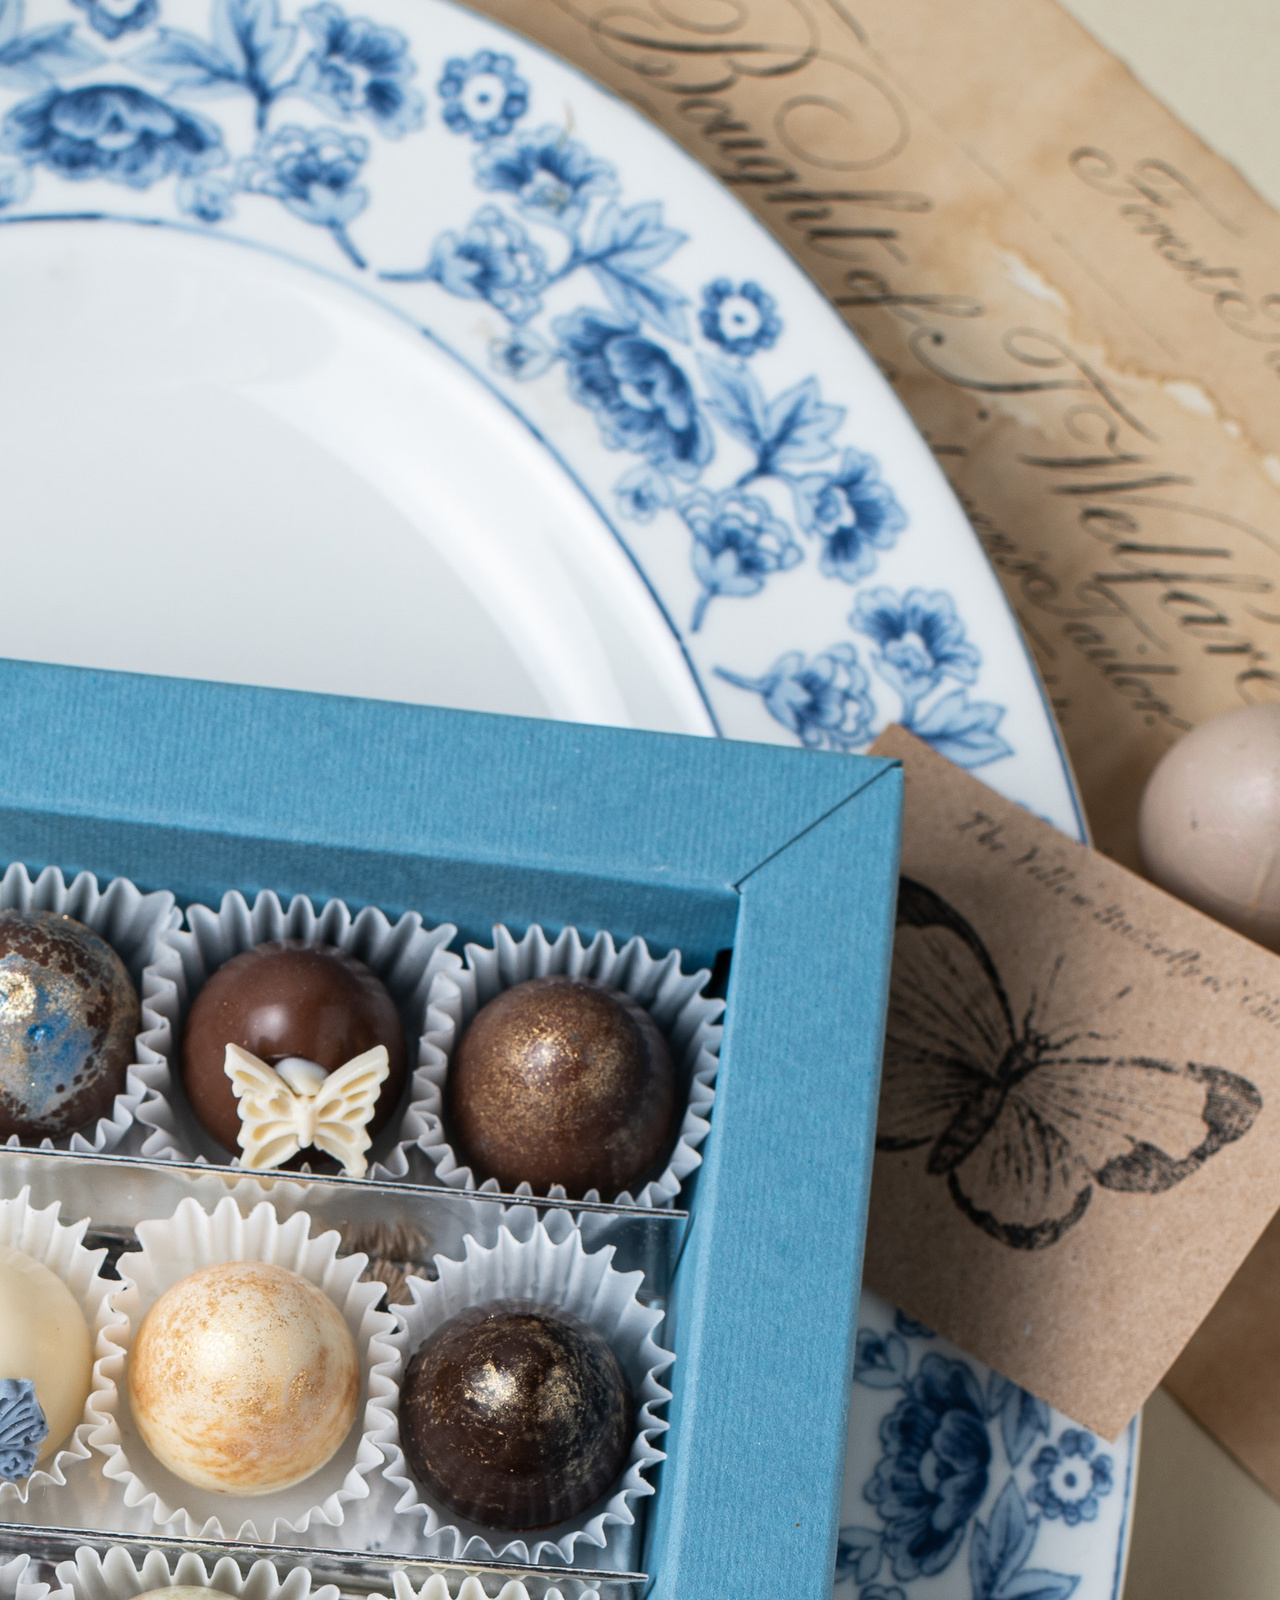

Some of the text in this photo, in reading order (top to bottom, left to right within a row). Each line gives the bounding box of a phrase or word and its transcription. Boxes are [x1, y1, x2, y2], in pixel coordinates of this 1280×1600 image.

[568, 0, 934, 264] Bought
[832, 268, 986, 326] of
[1068, 146, 1246, 288] Forest
